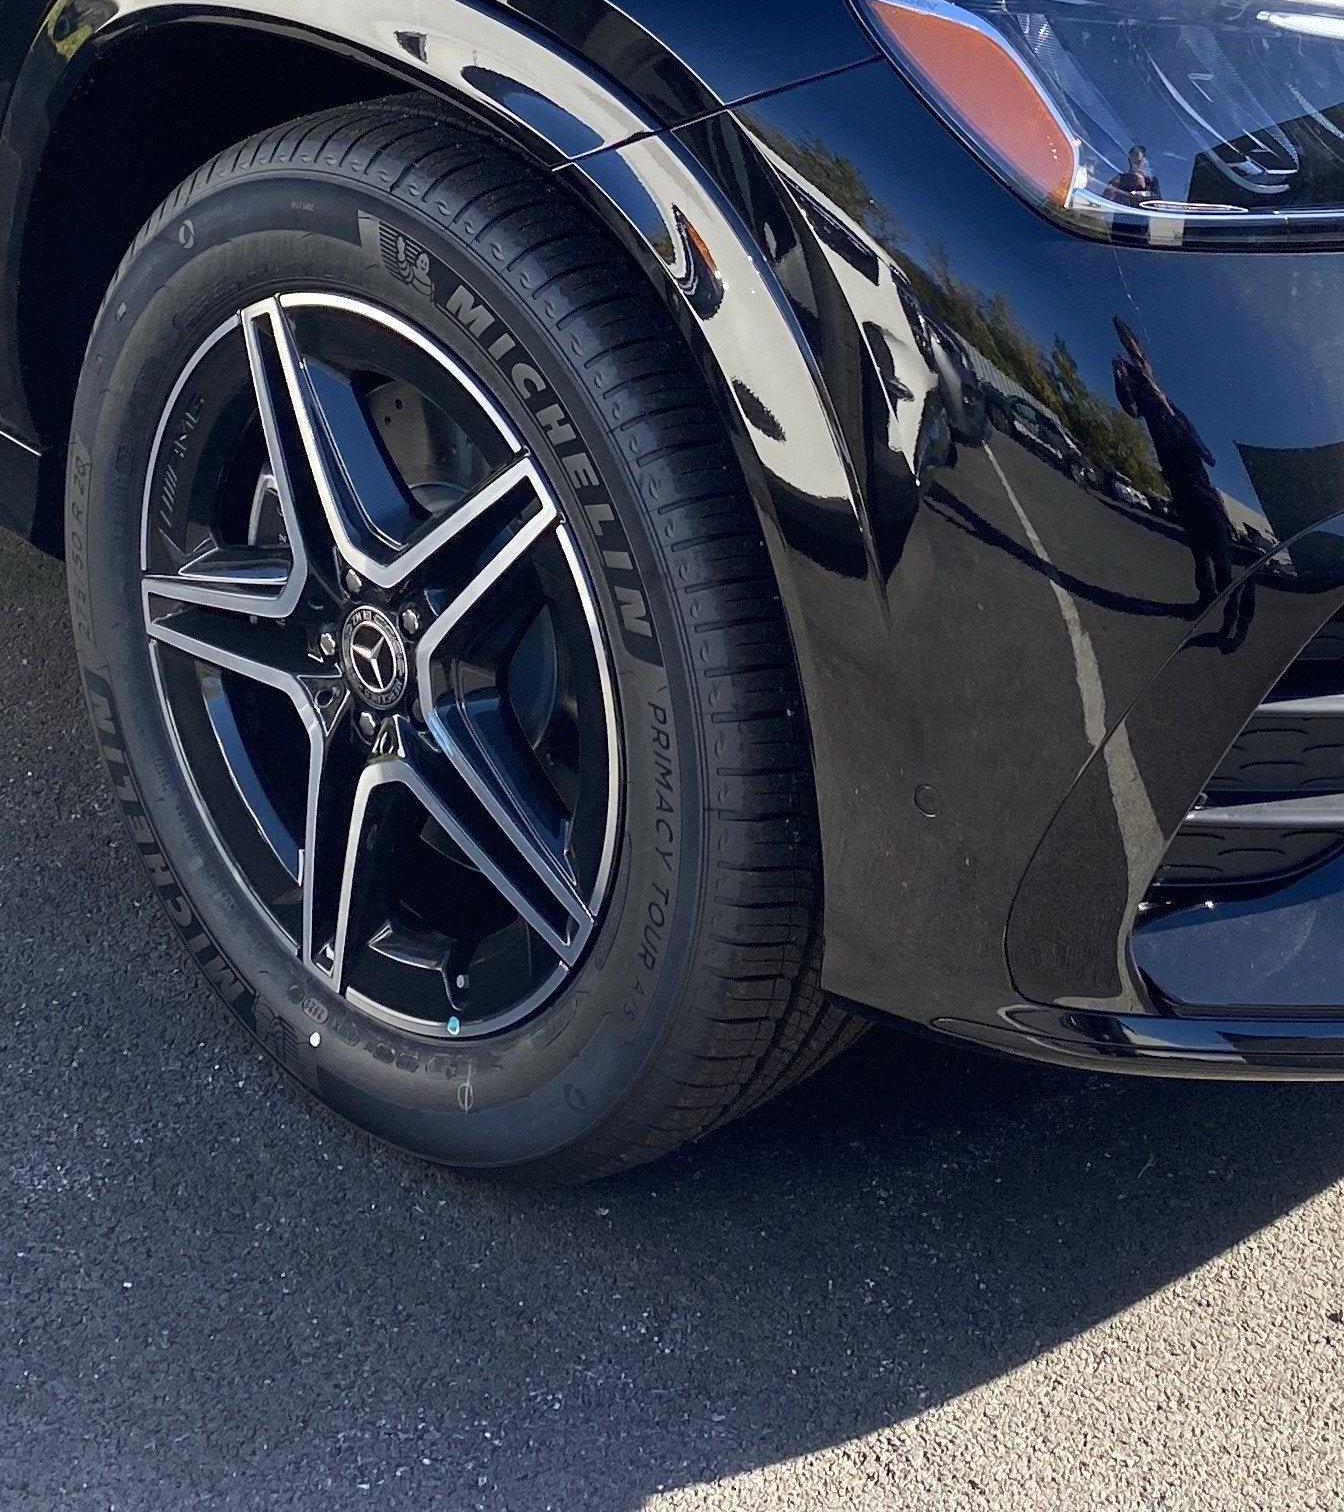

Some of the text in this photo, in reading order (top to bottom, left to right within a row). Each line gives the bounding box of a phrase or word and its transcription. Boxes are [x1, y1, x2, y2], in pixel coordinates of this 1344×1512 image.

[445, 284, 655, 641] MICHELIN
[647, 700, 674, 871] PRIMACY
[637, 881, 670, 971] TOUR
